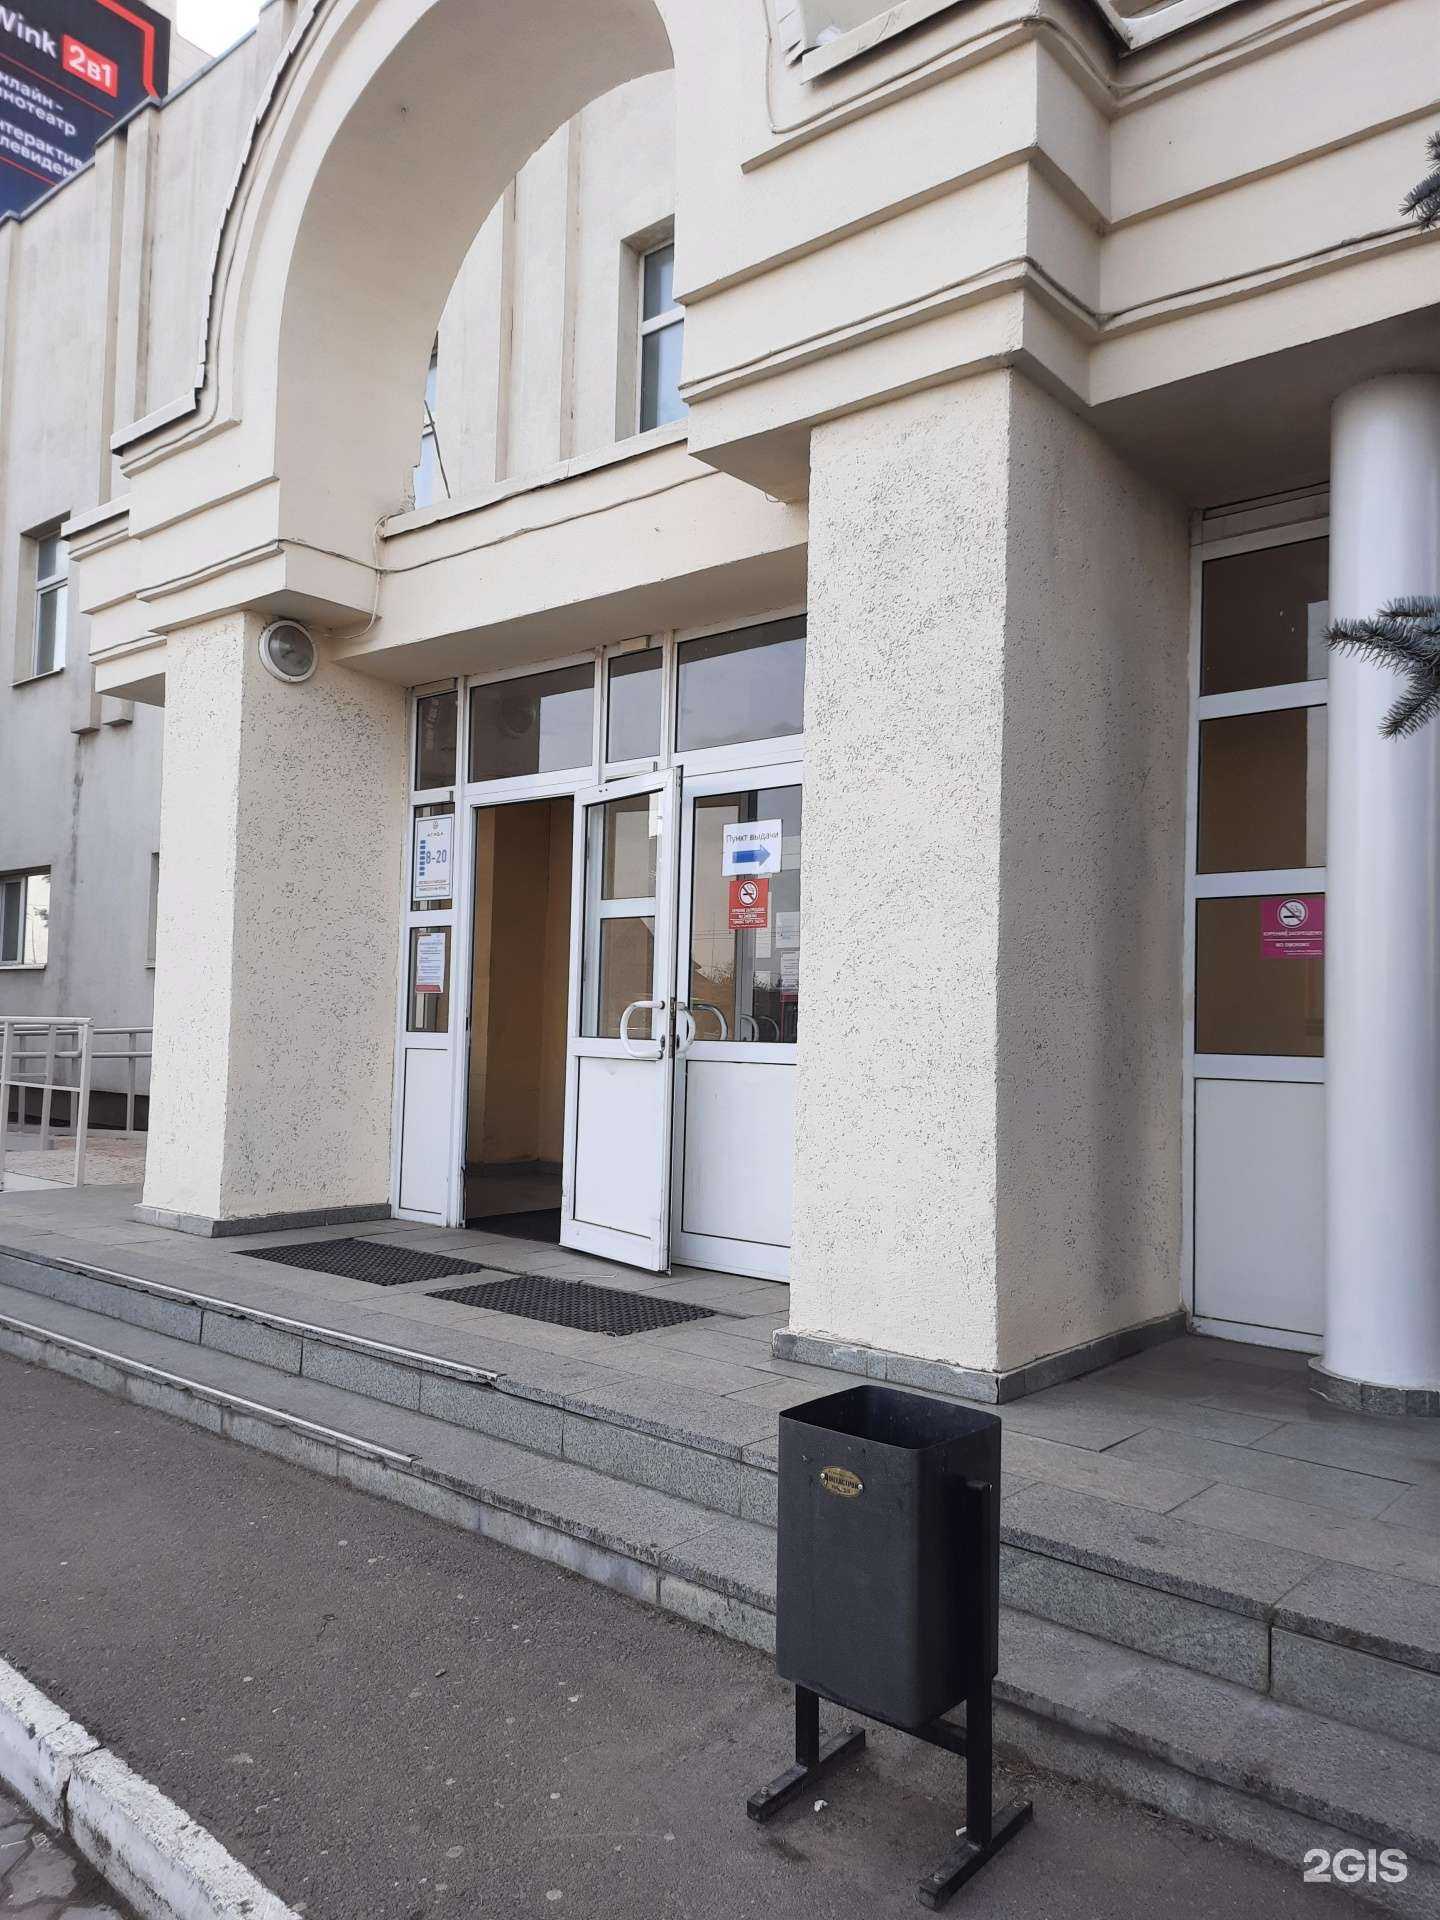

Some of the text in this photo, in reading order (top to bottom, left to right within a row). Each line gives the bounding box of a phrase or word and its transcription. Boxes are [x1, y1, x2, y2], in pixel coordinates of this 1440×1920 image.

[69, 44, 112, 88] 2в1
[0, 70, 63, 110] нлайн-
[0, 87, 77, 136] нотеатр
[727, 831, 779, 846] Пункт выдачи
